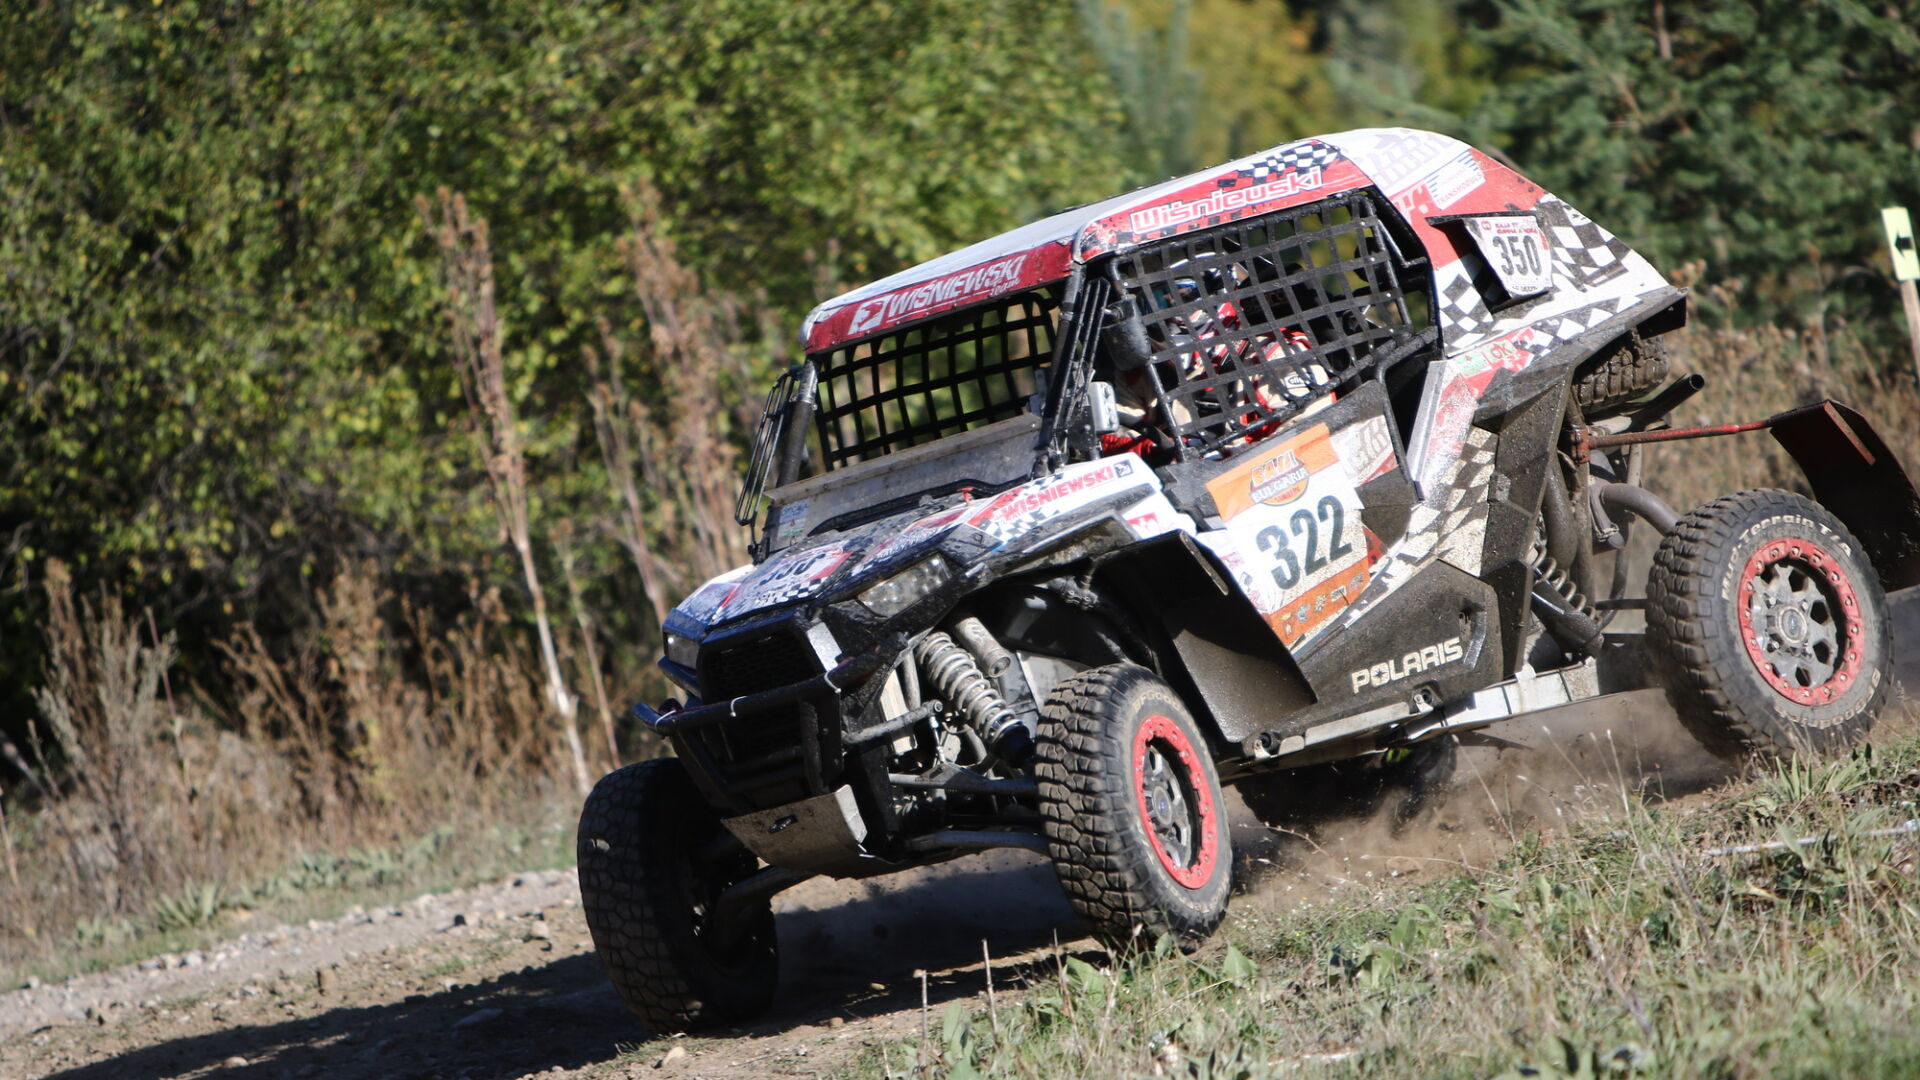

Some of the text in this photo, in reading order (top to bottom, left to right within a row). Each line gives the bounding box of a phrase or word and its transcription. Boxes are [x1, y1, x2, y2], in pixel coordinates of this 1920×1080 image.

[1492, 235, 1542, 276] 350
[887, 254, 1027, 318] WIŚNIEWSKI
[1251, 467, 1310, 505] BULGARIA
[1255, 495, 1353, 590] 322
[1351, 636, 1463, 694] POLARIS
